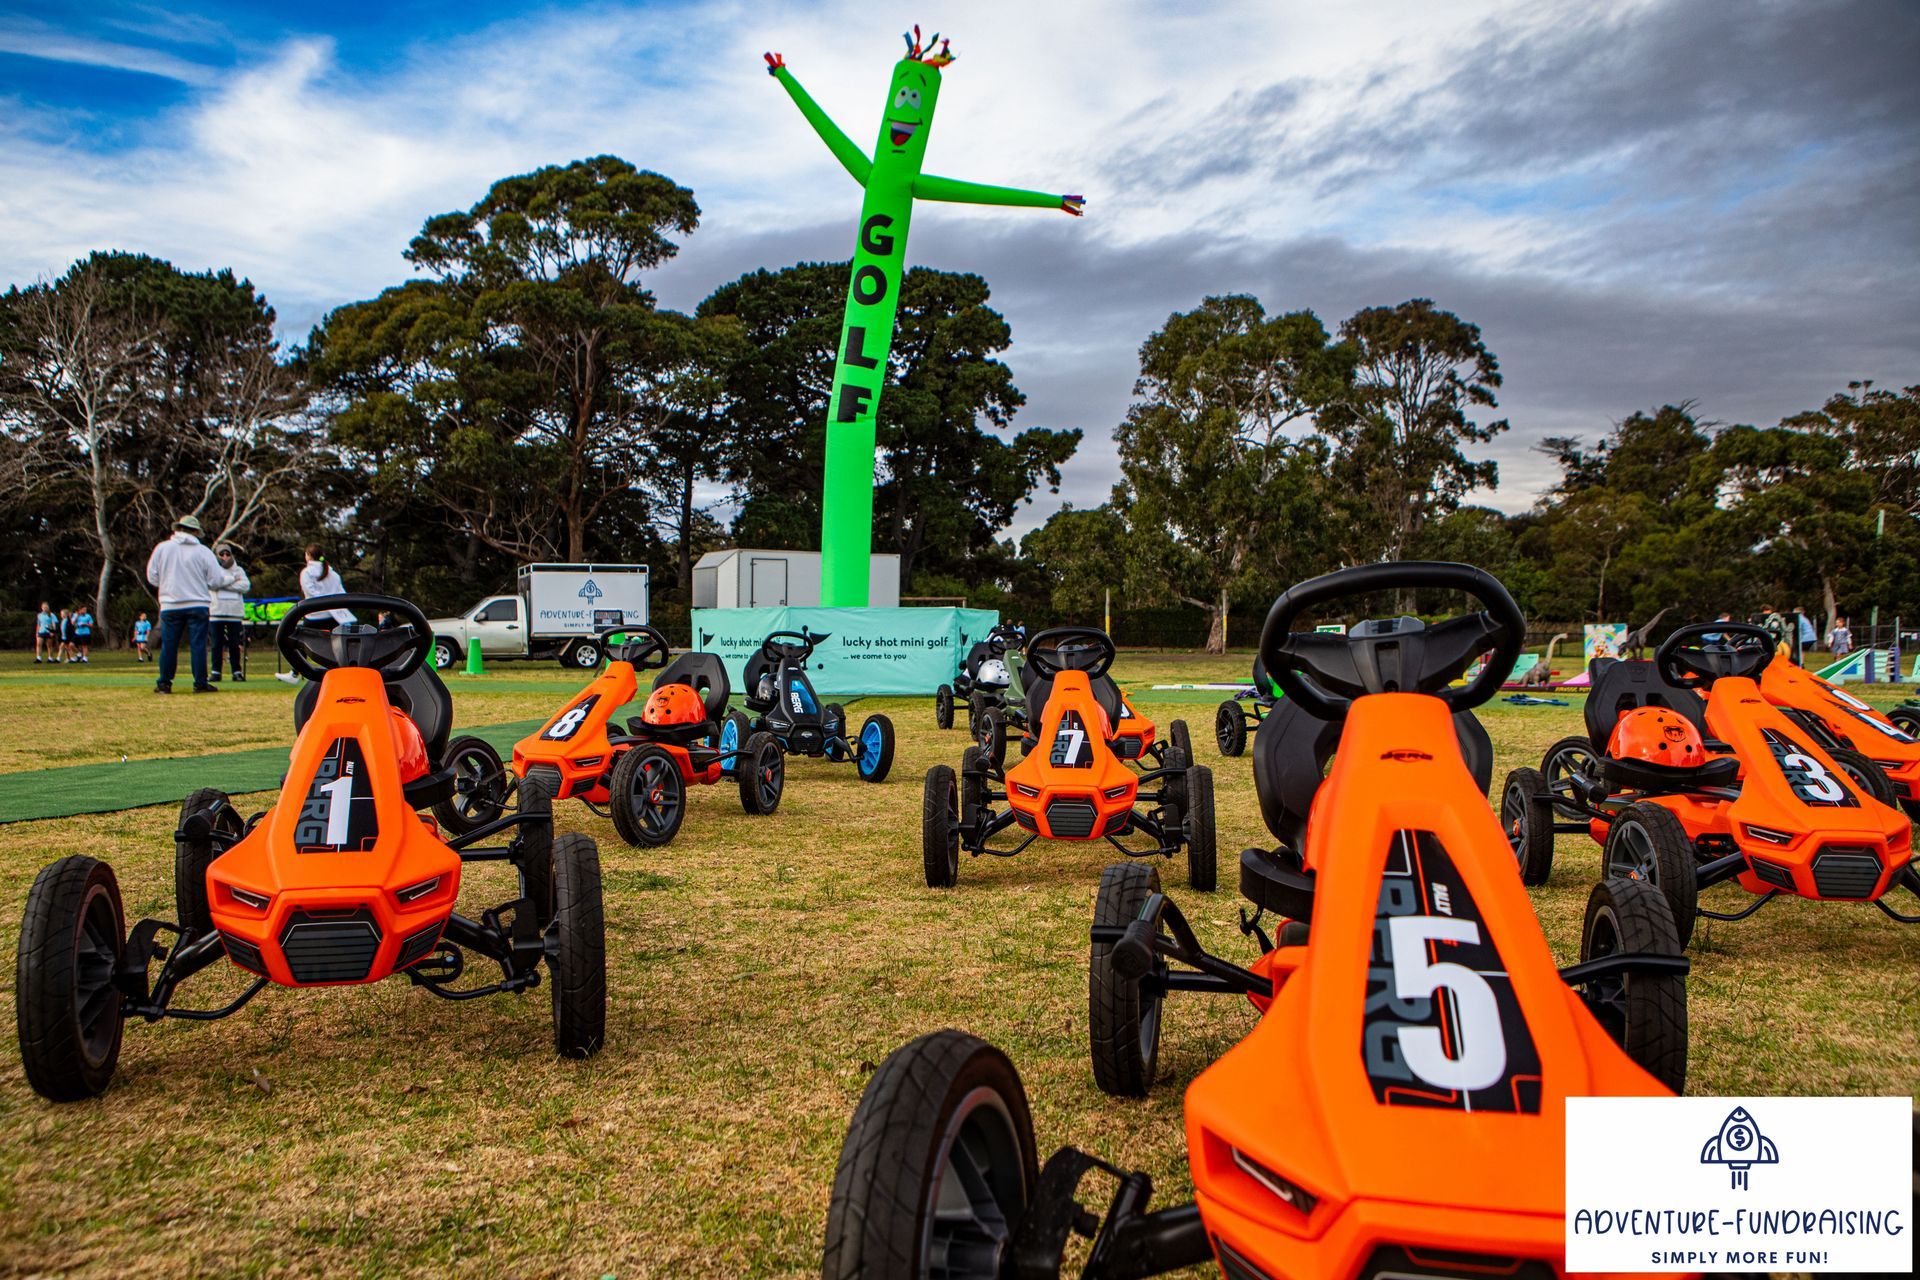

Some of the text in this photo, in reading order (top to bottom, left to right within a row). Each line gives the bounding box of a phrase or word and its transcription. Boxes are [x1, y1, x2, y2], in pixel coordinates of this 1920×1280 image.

[837, 214, 894, 423] GOLF
[540, 609, 639, 619] ADVENTURE-FING
[720, 637, 737, 649] lucky
[739, 637, 752, 647] shot
[843, 636, 949, 650] lucky shot mini golf
[791, 692, 804, 714] BERG
[549, 708, 587, 737] 8
[1058, 730, 1084, 764] 7
[1784, 753, 1844, 801] 3
[320, 776, 353, 845] 1
[1431, 882, 1453, 916] RALLY
[1388, 915, 1507, 1091] 5
